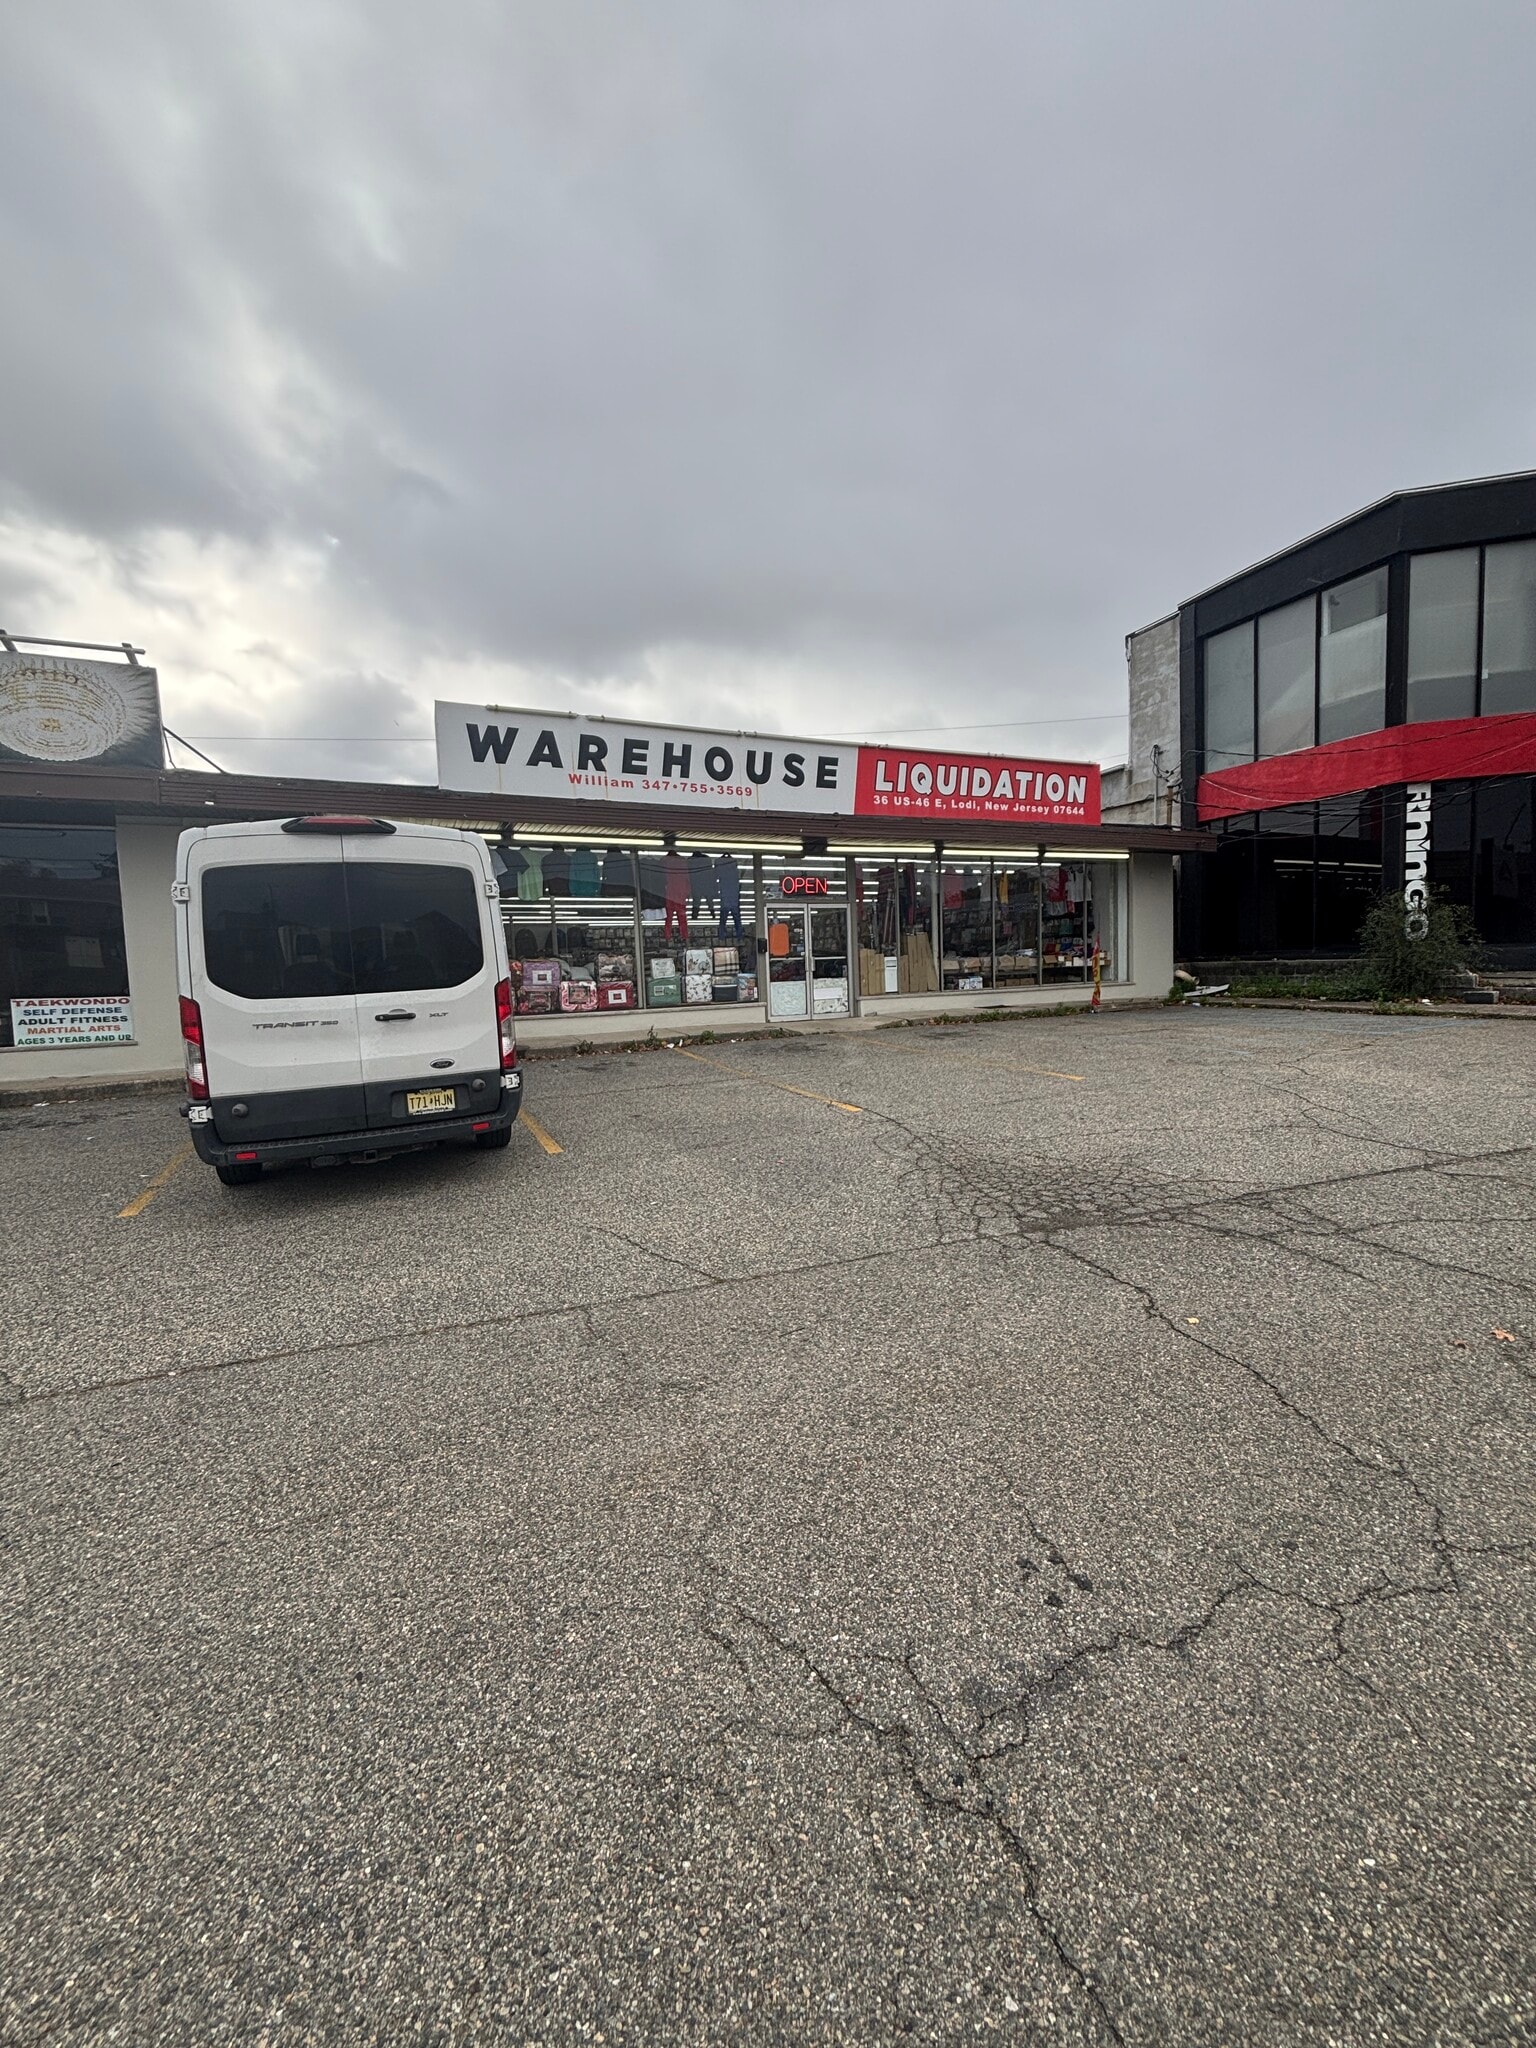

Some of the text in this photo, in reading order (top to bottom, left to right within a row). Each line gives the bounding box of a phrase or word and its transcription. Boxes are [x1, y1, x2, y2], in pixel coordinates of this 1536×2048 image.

[466, 723, 840, 790] WAREHOUSE
[568, 773, 634, 789] William
[874, 760, 1088, 804] LIQUIDATION
[873, 795, 1085, 816] 36 US-46 E, Lodi, New Jersey 07644
[782, 876, 828, 894] OPEN
[12, 998, 131, 1007] TAEKWONDO
[62, 1007, 122, 1015] DEFENSE
[18, 1018, 66, 1026] ADULT
[252, 1020, 319, 1029] TRANSIT
[27, 1024, 121, 1035] MARTIAL ARTS
[17, 1037, 46, 1046] AGES
[57, 1035, 92, 1044] YEARS
[94, 1034, 116, 1042] AND
